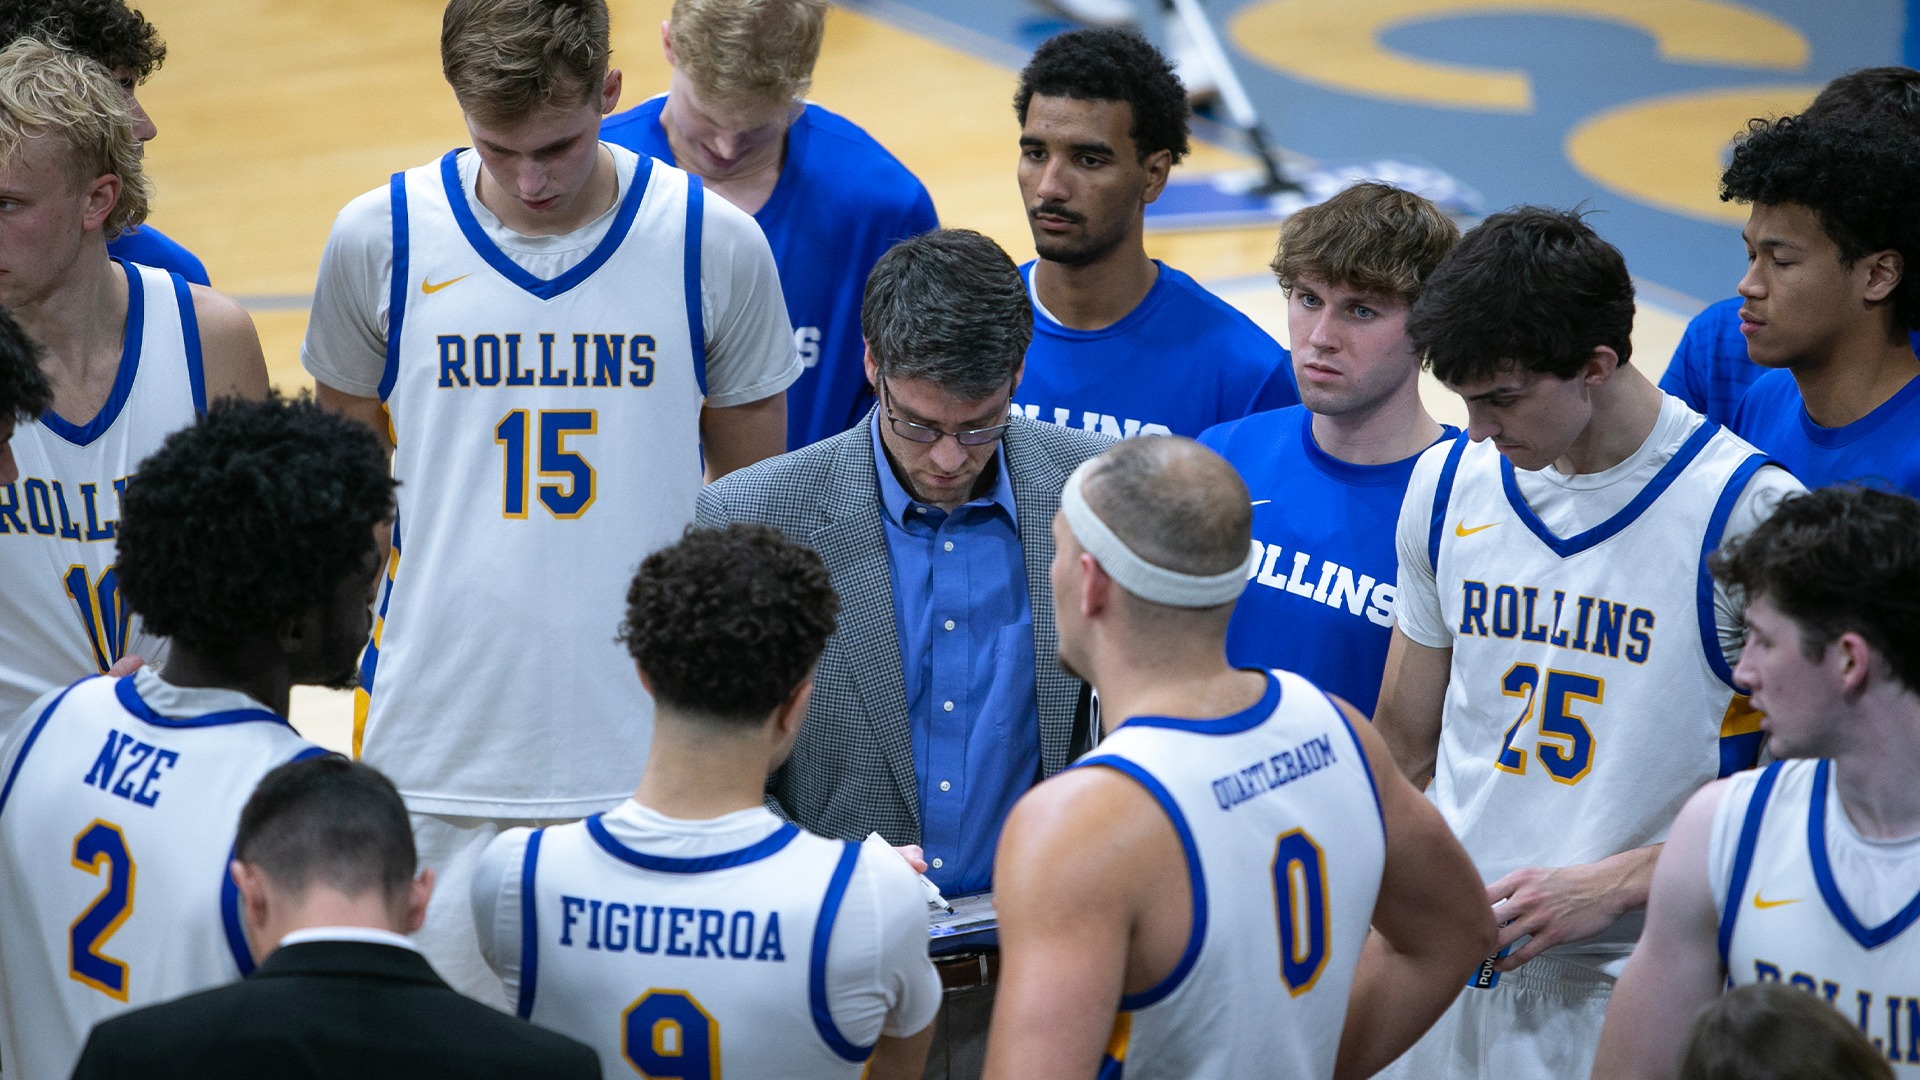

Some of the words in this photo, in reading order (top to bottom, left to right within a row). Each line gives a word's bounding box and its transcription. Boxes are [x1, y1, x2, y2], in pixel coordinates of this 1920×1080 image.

[436, 332, 657, 388] ROLLINS
[494, 408, 598, 520] 15
[0, 476, 138, 543] ROLL
[63, 563, 131, 675] 10
[1459, 579, 1656, 665] ROLLINS
[83, 728, 180, 808] NZE
[1494, 661, 1605, 786] 25
[1211, 734, 1337, 812] QUARTLEBAUM
[68, 817, 136, 1004] 2
[559, 895, 786, 962] FIGUEROA
[1270, 826, 1332, 999] 0
[620, 987, 723, 1080] 9
